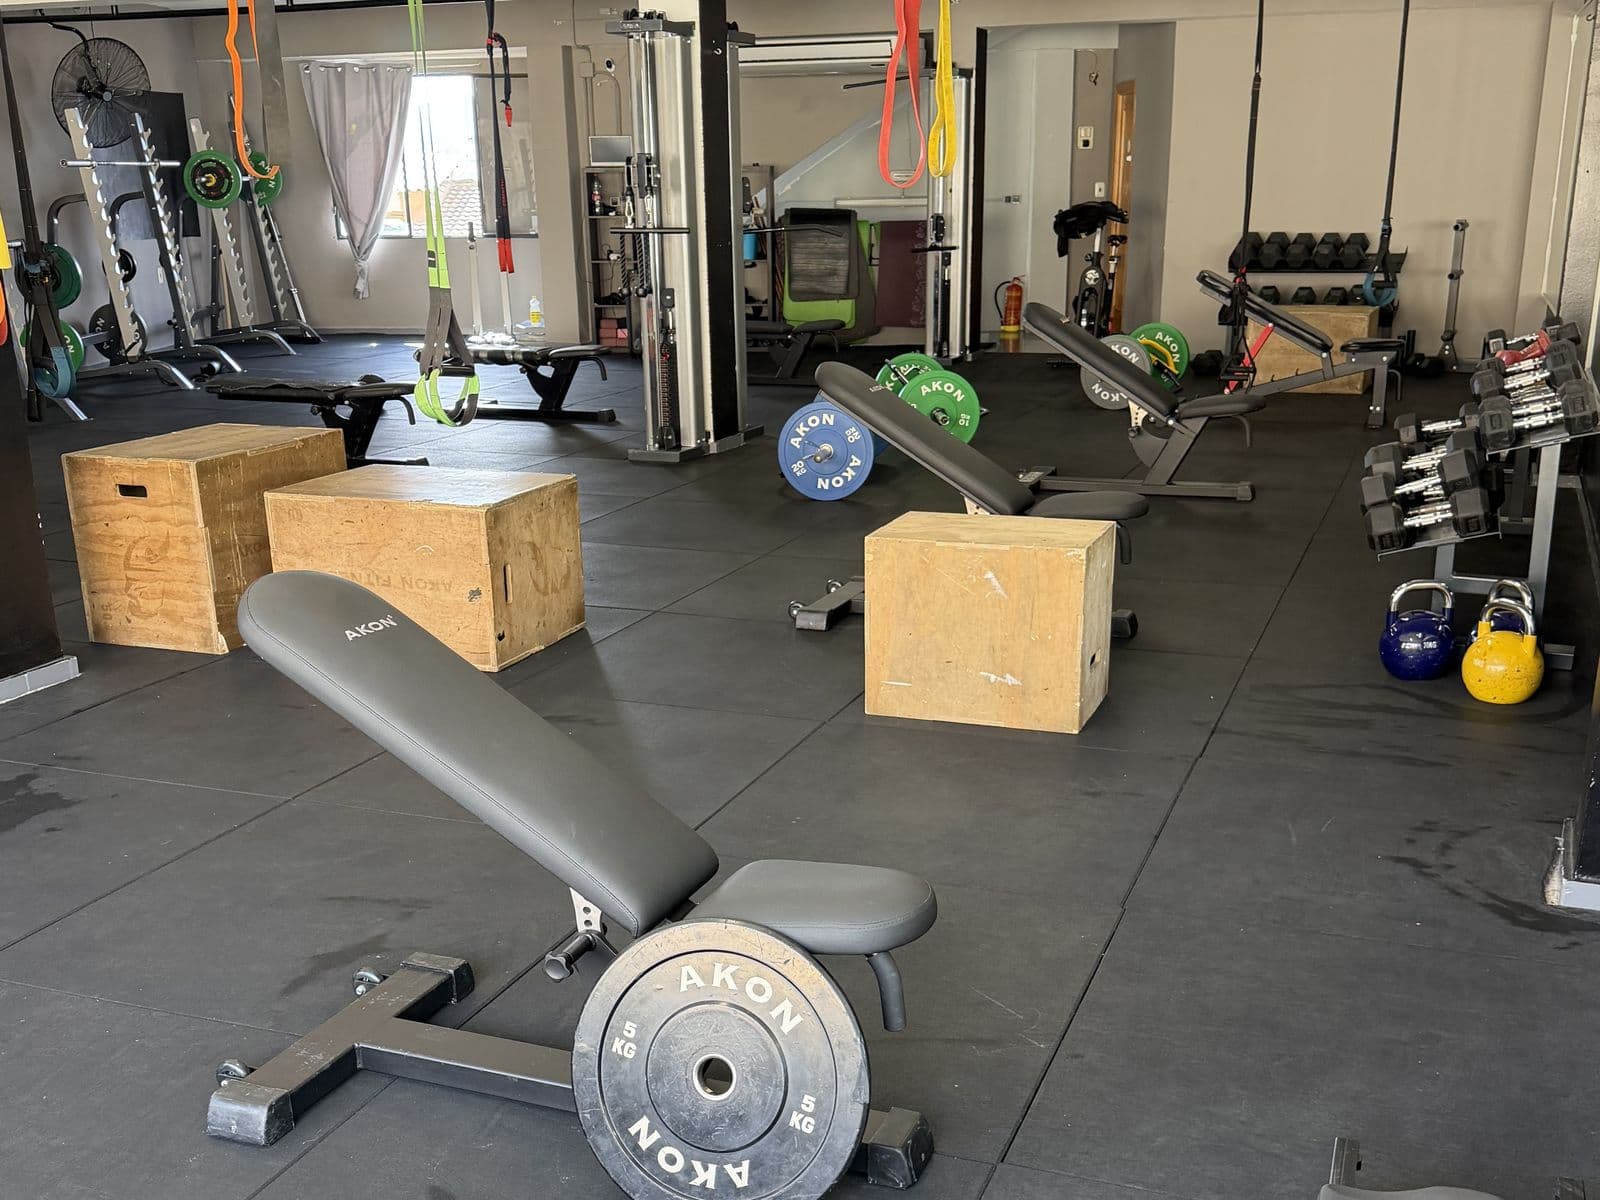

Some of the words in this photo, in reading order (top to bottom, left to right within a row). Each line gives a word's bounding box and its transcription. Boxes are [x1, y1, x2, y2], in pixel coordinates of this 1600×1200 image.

[1111, 344, 1140, 364] KON
[1155, 332, 1180, 363] AKON
[920, 381, 965, 402] AKON
[1091, 383, 1128, 402] KON
[790, 413, 835, 449] AKON
[817, 454, 862, 490] AKON
[344, 615, 398, 641] AKON
[679, 962, 804, 1035] AKON
[623, 1020, 638, 1038] 5
[611, 1037, 637, 1059] KG
[800, 1094, 816, 1113] 5
[789, 1111, 816, 1134] KG
[627, 1115, 751, 1190] AKON
